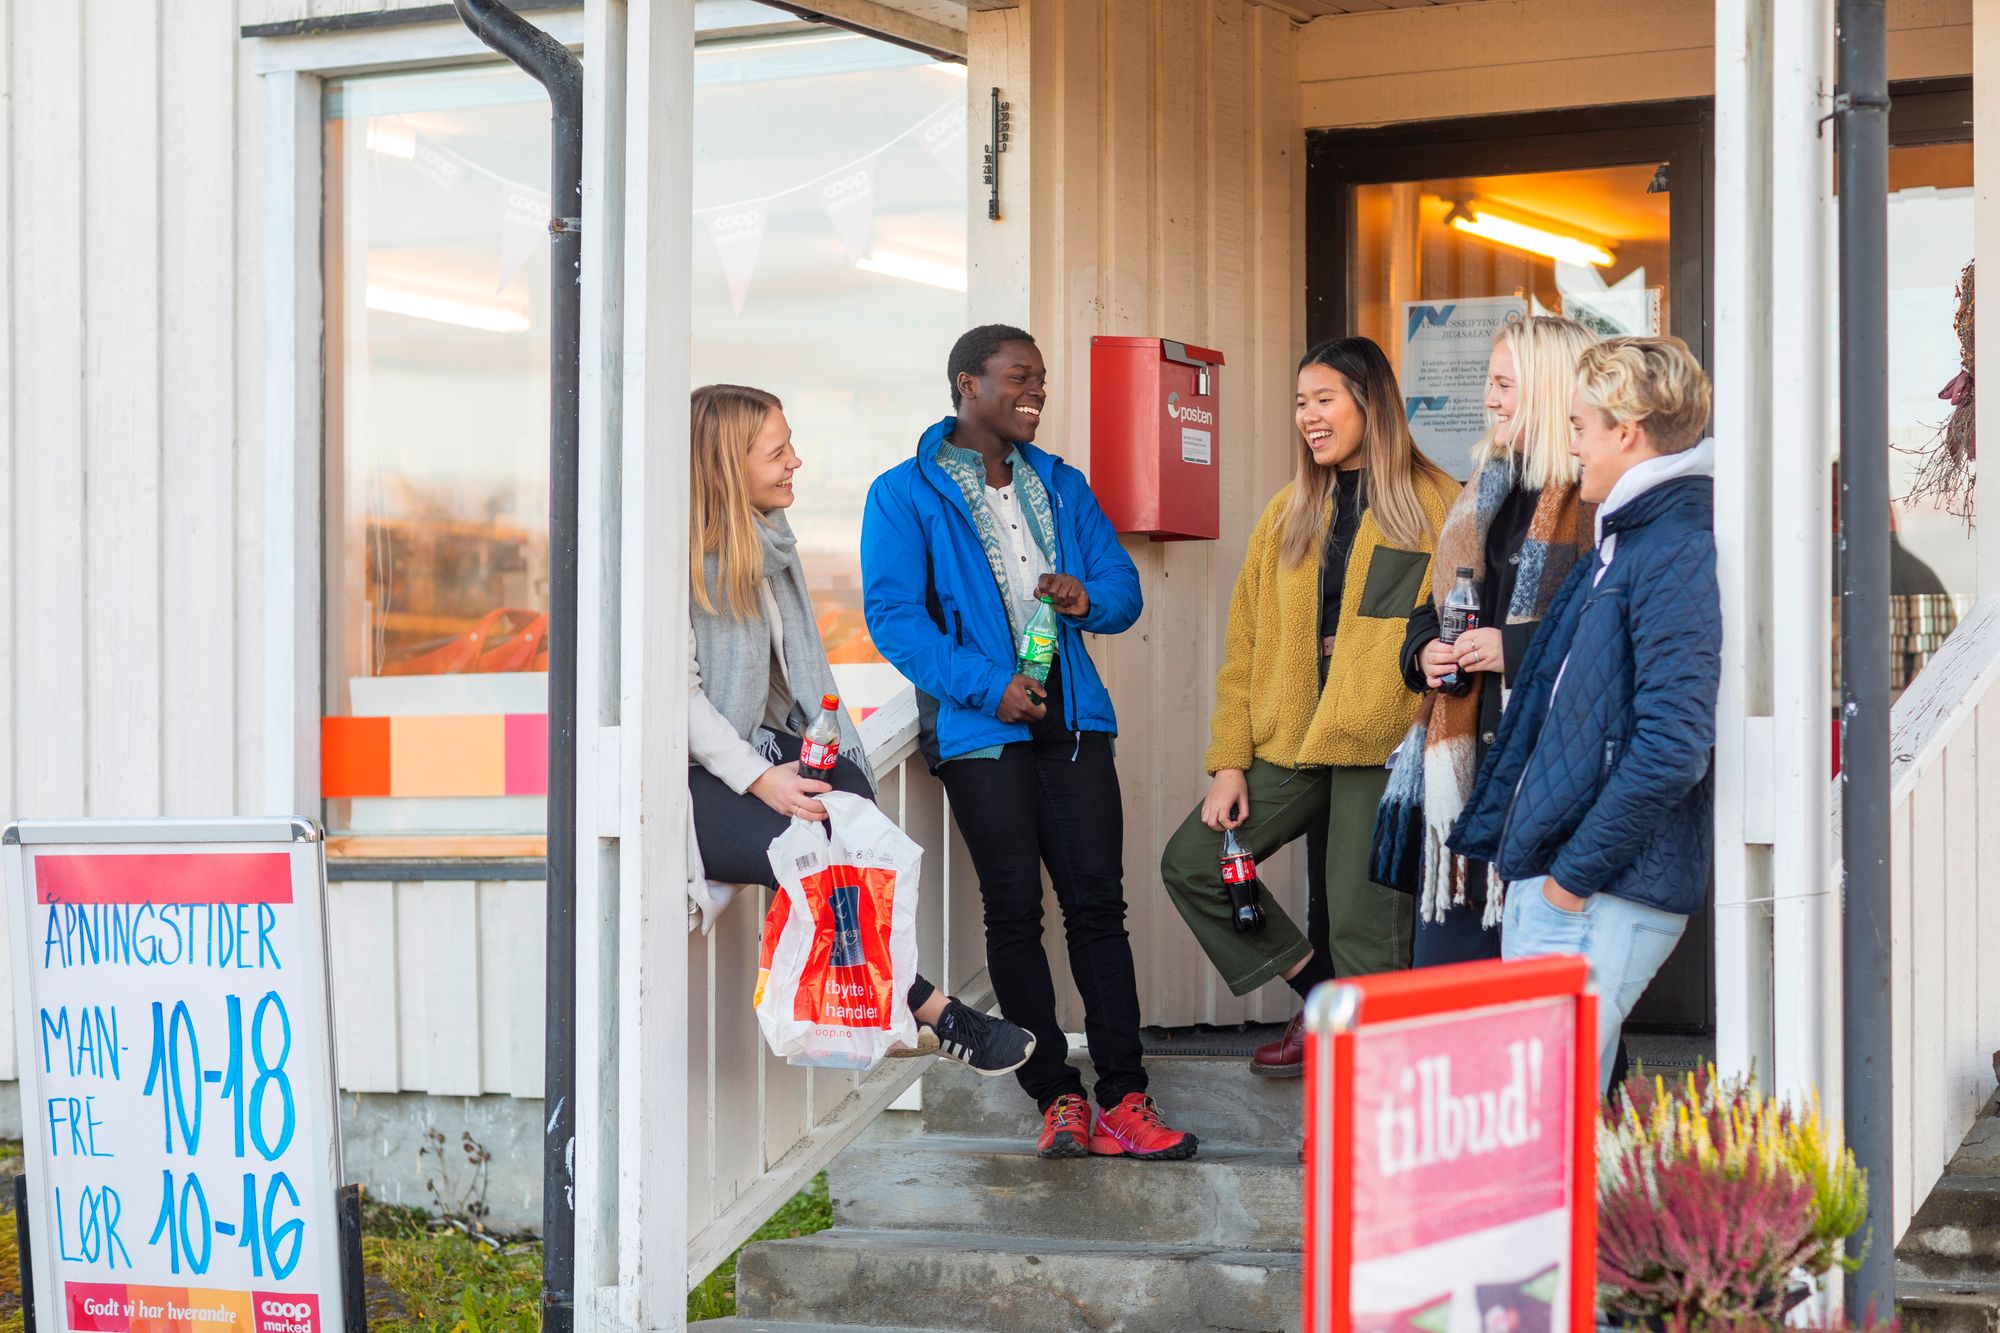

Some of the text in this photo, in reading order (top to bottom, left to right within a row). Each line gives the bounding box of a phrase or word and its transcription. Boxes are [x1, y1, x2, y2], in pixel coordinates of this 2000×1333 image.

[822, 171, 867, 199] coop
[714, 211, 760, 230] coop
[1180, 406, 1213, 425] posten
[45, 893, 282, 970] ÅPNINGSTIDER
[825, 980, 864, 999] tbytte
[40, 1005, 129, 1081] MAN-
[815, 1029, 852, 1038] oop.no
[143, 990, 296, 1161] 10-18
[1375, 1037, 1544, 1176] tilbud!
[49, 1096, 115, 1157] FRE
[56, 1169, 305, 1280] LØR 10-16
[83, 1298, 237, 1324] Godt vi har hverandre
[261, 1300, 312, 1321] coop
[263, 1319, 312, 1333] marked
